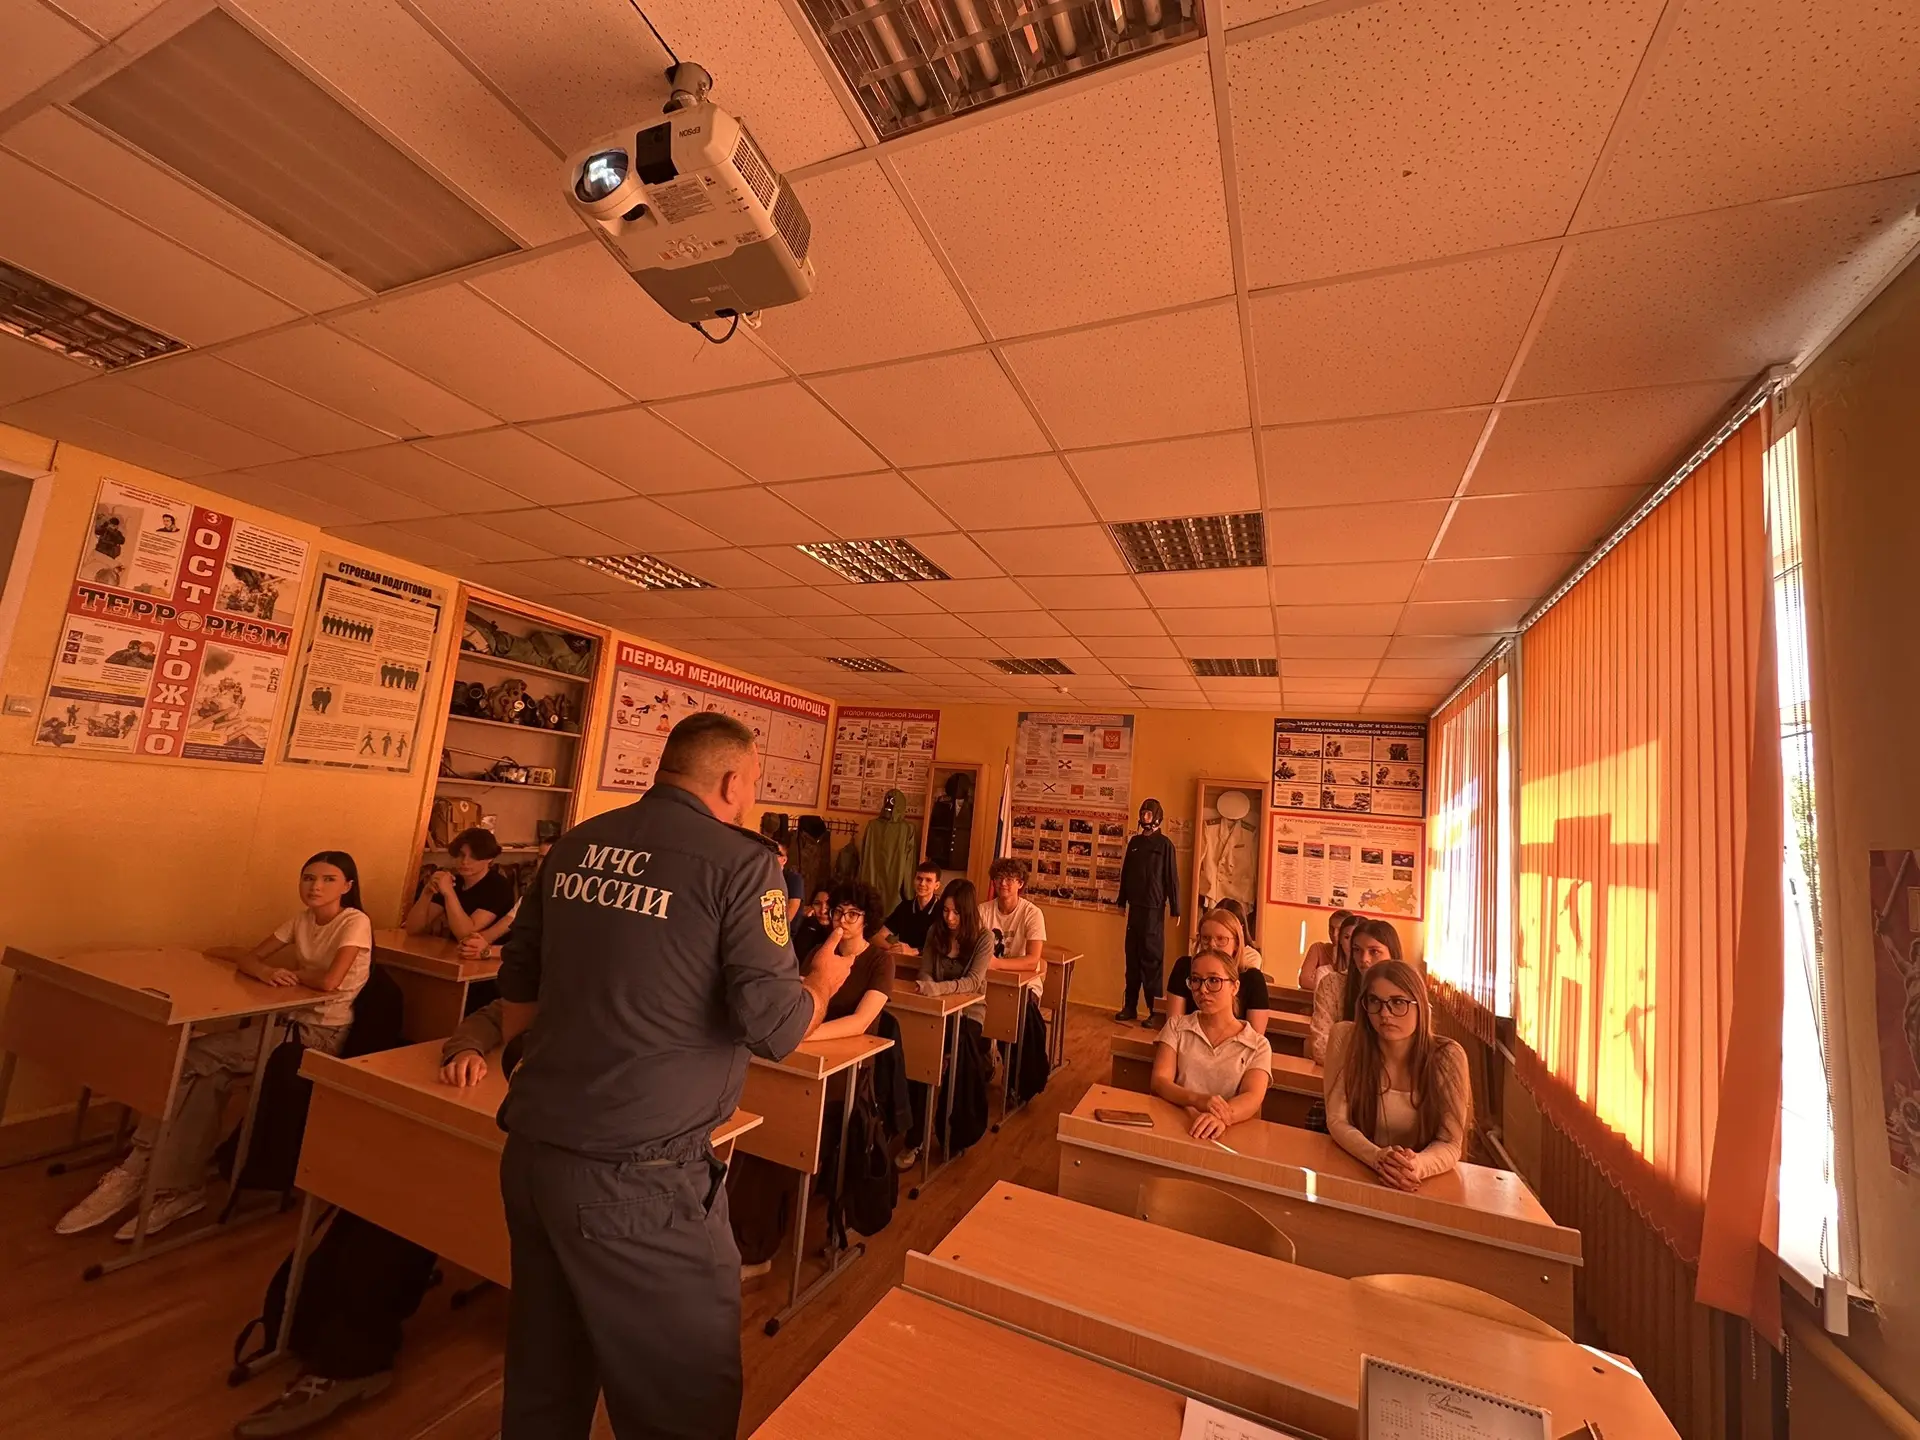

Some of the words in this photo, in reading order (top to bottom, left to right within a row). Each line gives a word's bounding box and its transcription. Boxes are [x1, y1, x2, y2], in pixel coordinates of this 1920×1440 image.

[679, 126, 701, 138] EPSON
[338, 562, 382, 584] СТРОЕВАЯ
[382, 575, 433, 599] ПОДГОТОВКА
[621, 646, 685, 677] ПЕРВАЯ
[688, 665, 781, 704] МЕДИЦИНСКАЯ
[783, 691, 828, 718] ПОМОЩЬ
[865, 711, 907, 719] ГРАЖДАНСКОЙ
[907, 712, 934, 720] ЗАЩИТЫ
[578, 843, 652, 877] МЧС
[551, 872, 673, 919] РОССИИ
